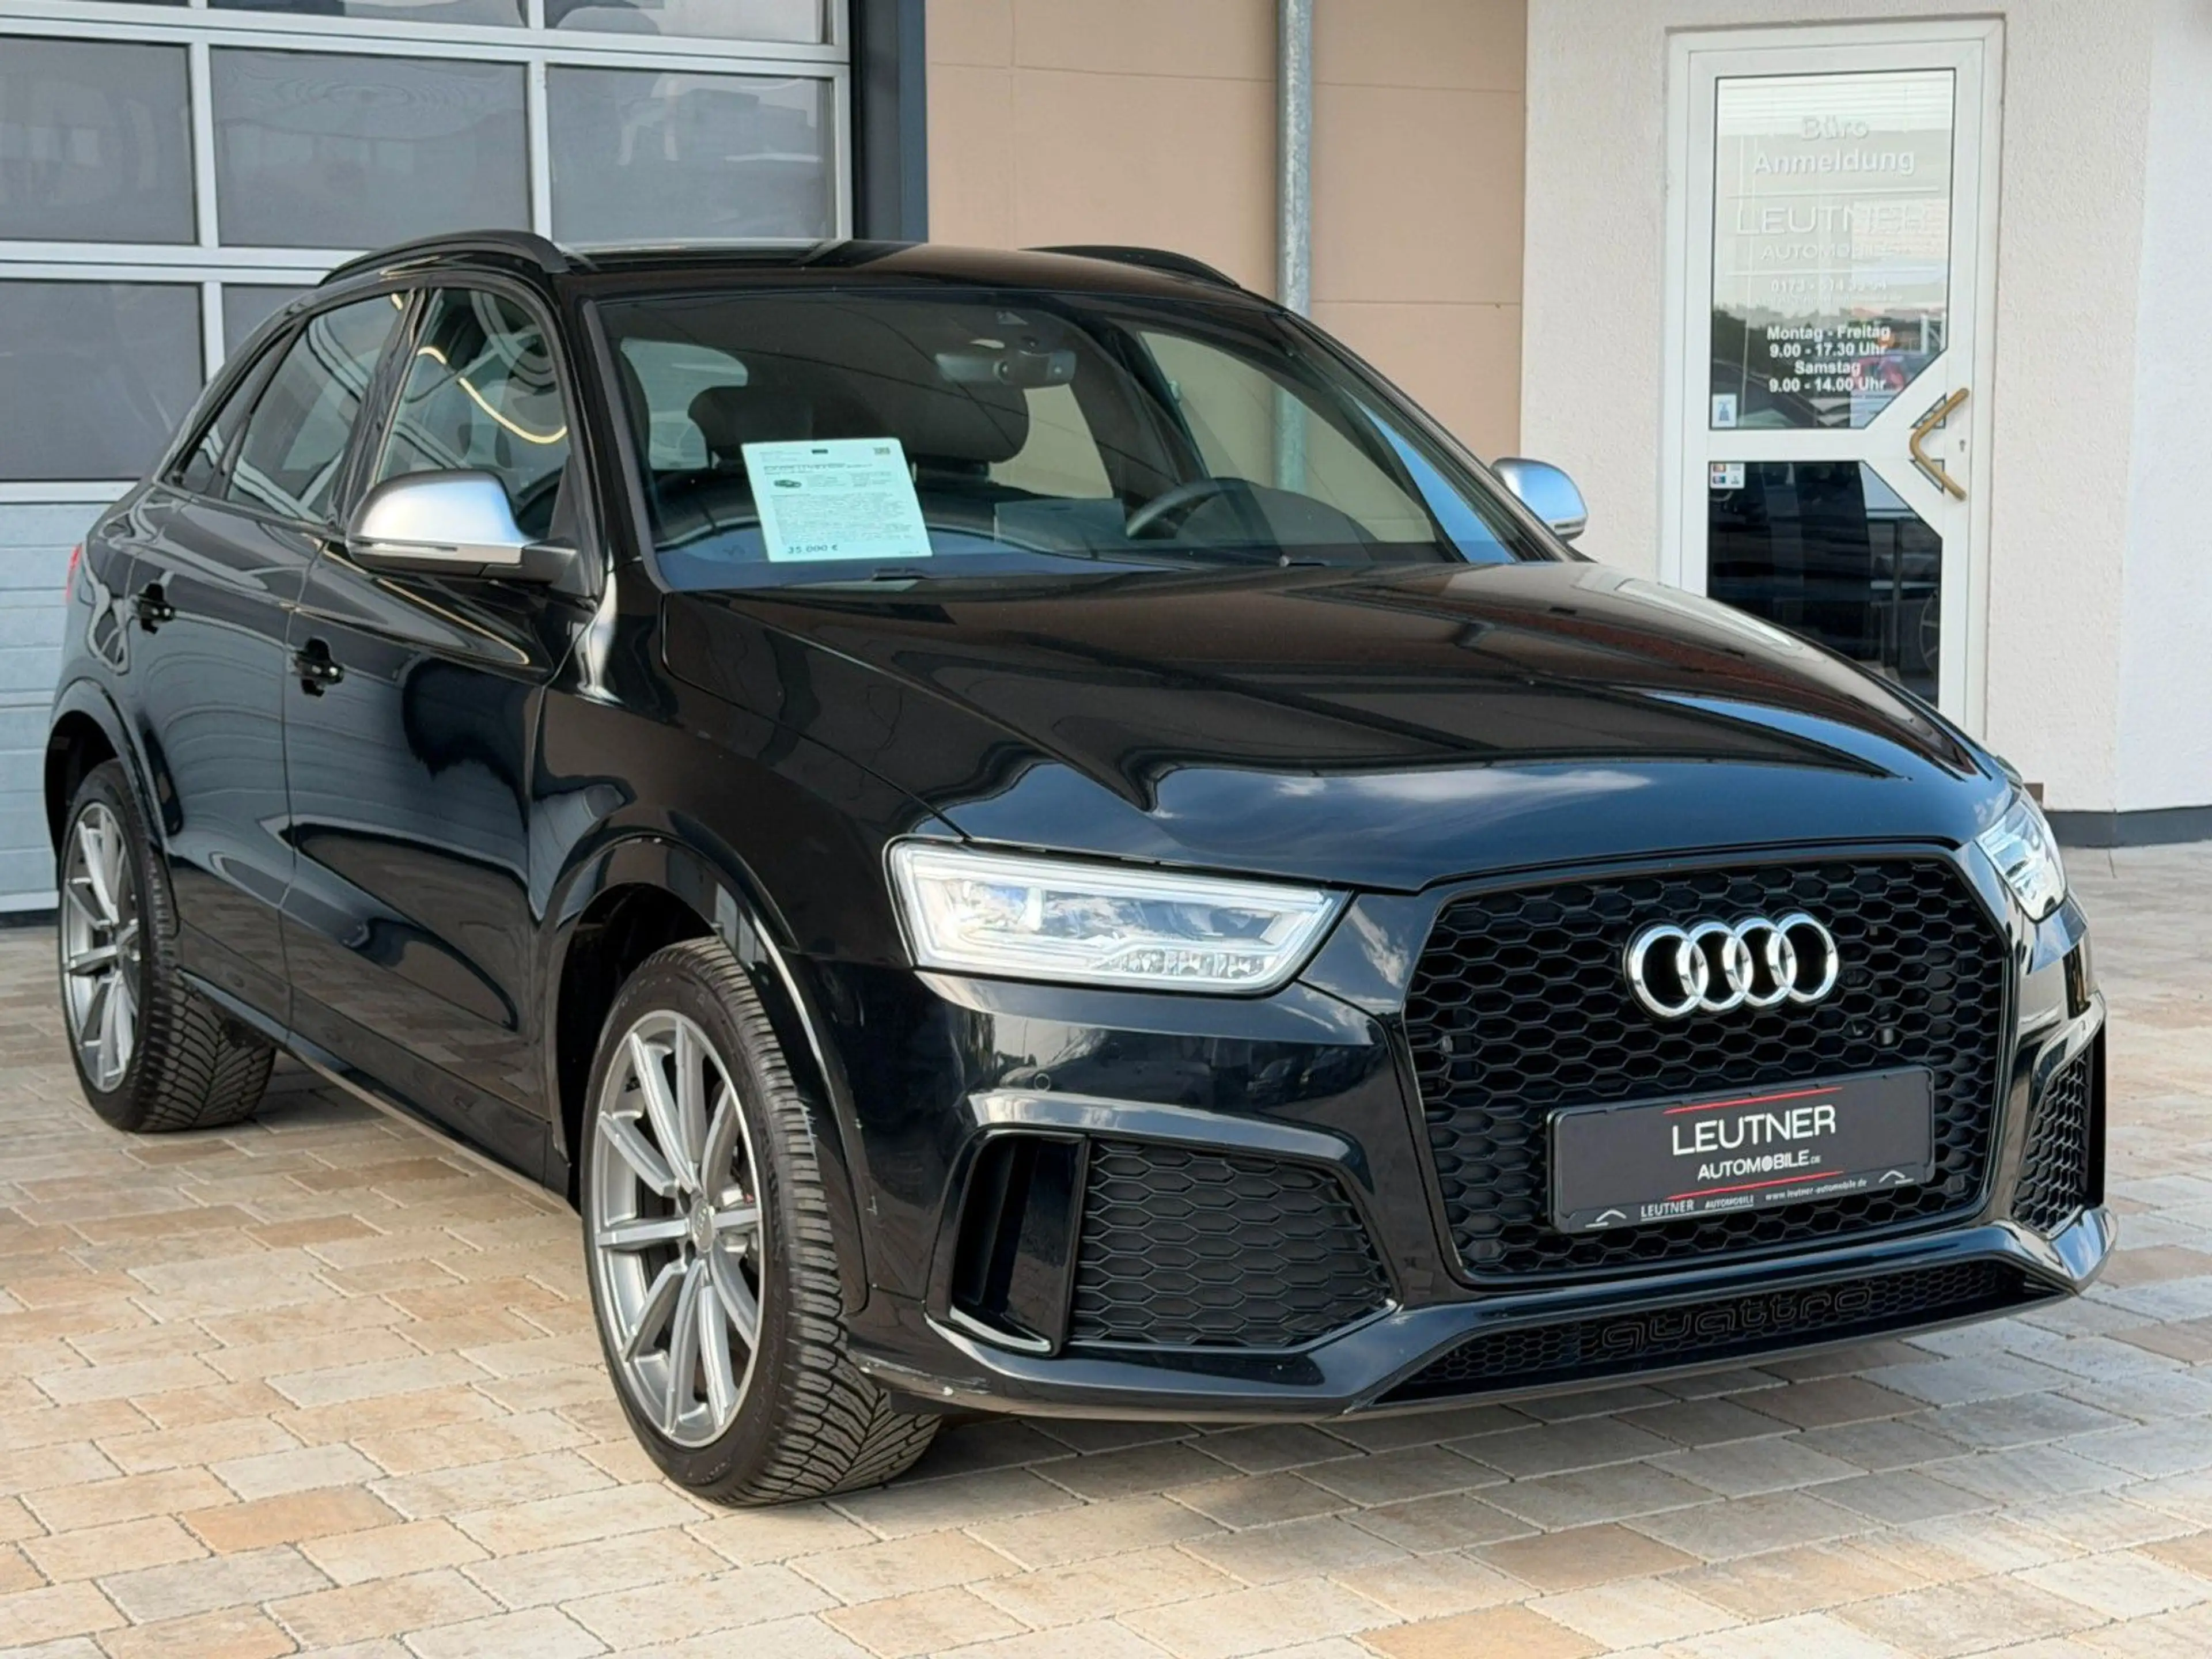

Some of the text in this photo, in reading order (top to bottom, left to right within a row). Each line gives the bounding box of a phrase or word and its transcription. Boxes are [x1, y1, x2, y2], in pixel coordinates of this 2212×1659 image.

[1801, 116, 1870, 140] Büro
[1754, 148, 1915, 176] Anmeldung
[1767, 325, 1823, 342] Montag
[1837, 324, 1891, 341] Freitag
[1770, 343, 1801, 358] 9.00
[1815, 342, 1855, 357] 17.30
[1859, 341, 1888, 355] Uhr
[1794, 359, 1861, 377] Samstag
[1769, 377, 1801, 392] 9.00
[1815, 376, 1854, 392] 14.00
[1858, 376, 1887, 390] Uhr
[1672, 1104, 1836, 1156] LEUTNER
[1640, 1199, 1695, 1218] LEUTNER
[1603, 1285, 1873, 1349] quattro
